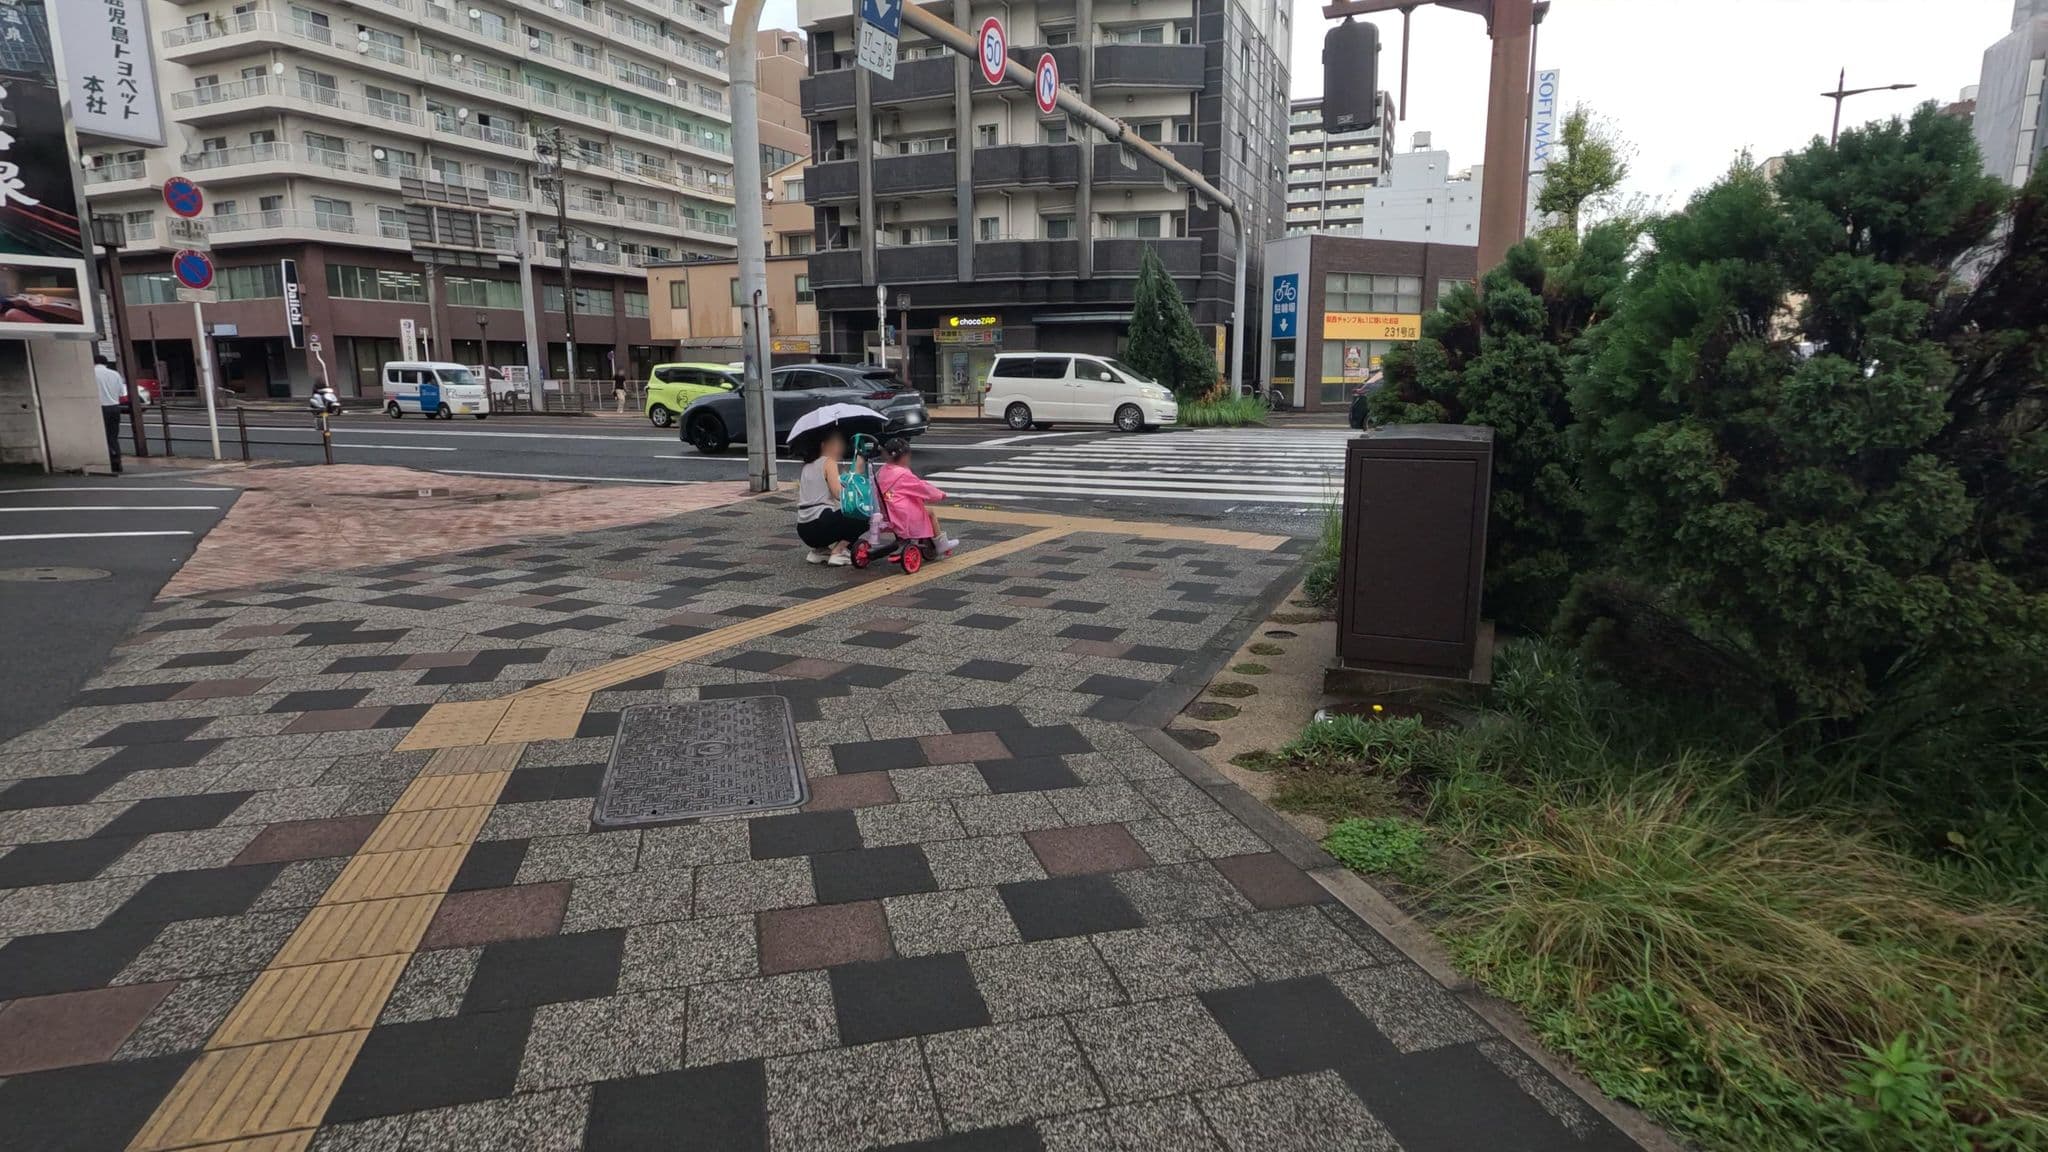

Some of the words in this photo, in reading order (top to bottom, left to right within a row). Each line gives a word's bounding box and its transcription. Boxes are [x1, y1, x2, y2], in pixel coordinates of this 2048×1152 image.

[0, 0, 24, 42] 温泉
[986, 35, 1001, 66] 50
[83, 75, 107, 115] 本社
[1538, 72, 1556, 117] SOFT
[1535, 122, 1551, 161] MAX
[287, 283, 302, 326] Daiichi
[960, 317, 996, 326] chocoZAP
[1384, 326, 1416, 338] 231号店
